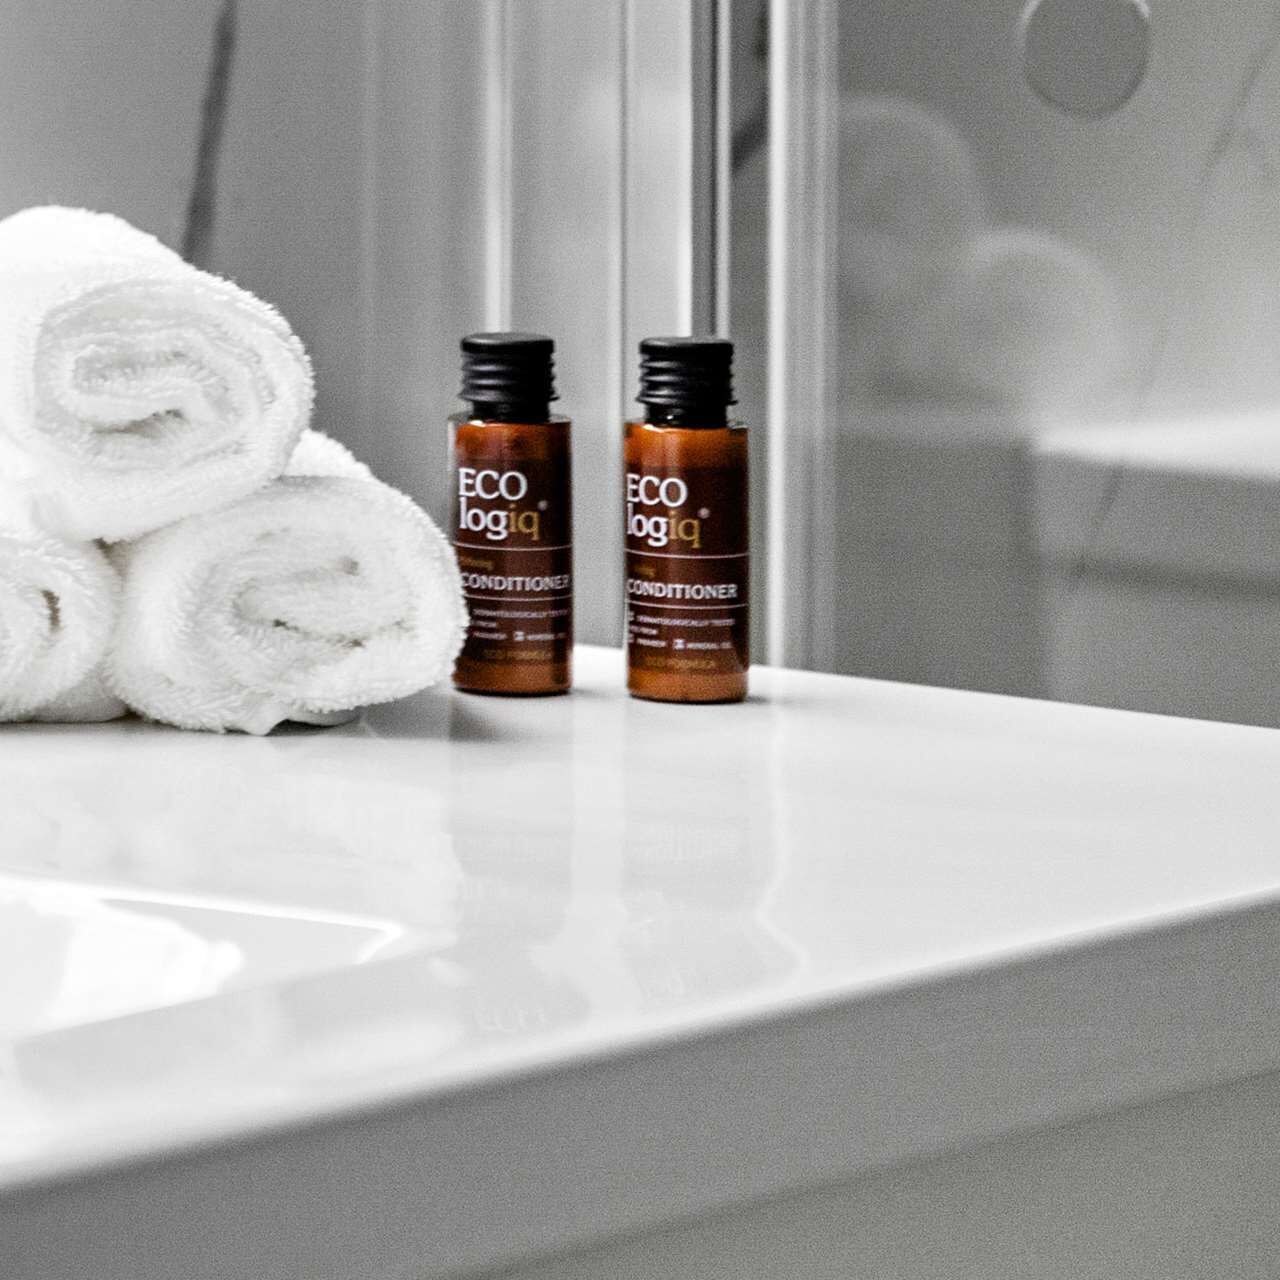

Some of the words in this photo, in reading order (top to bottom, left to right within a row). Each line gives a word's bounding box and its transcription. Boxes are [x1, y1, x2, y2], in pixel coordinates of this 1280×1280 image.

[458, 467, 528, 500] ECO
[626, 473, 688, 508] ECO
[458, 496, 540, 541] logiq
[626, 502, 702, 550] logiq
[460, 572, 570, 592] CONDITIONER
[627, 578, 738, 600] CONDITIONER
